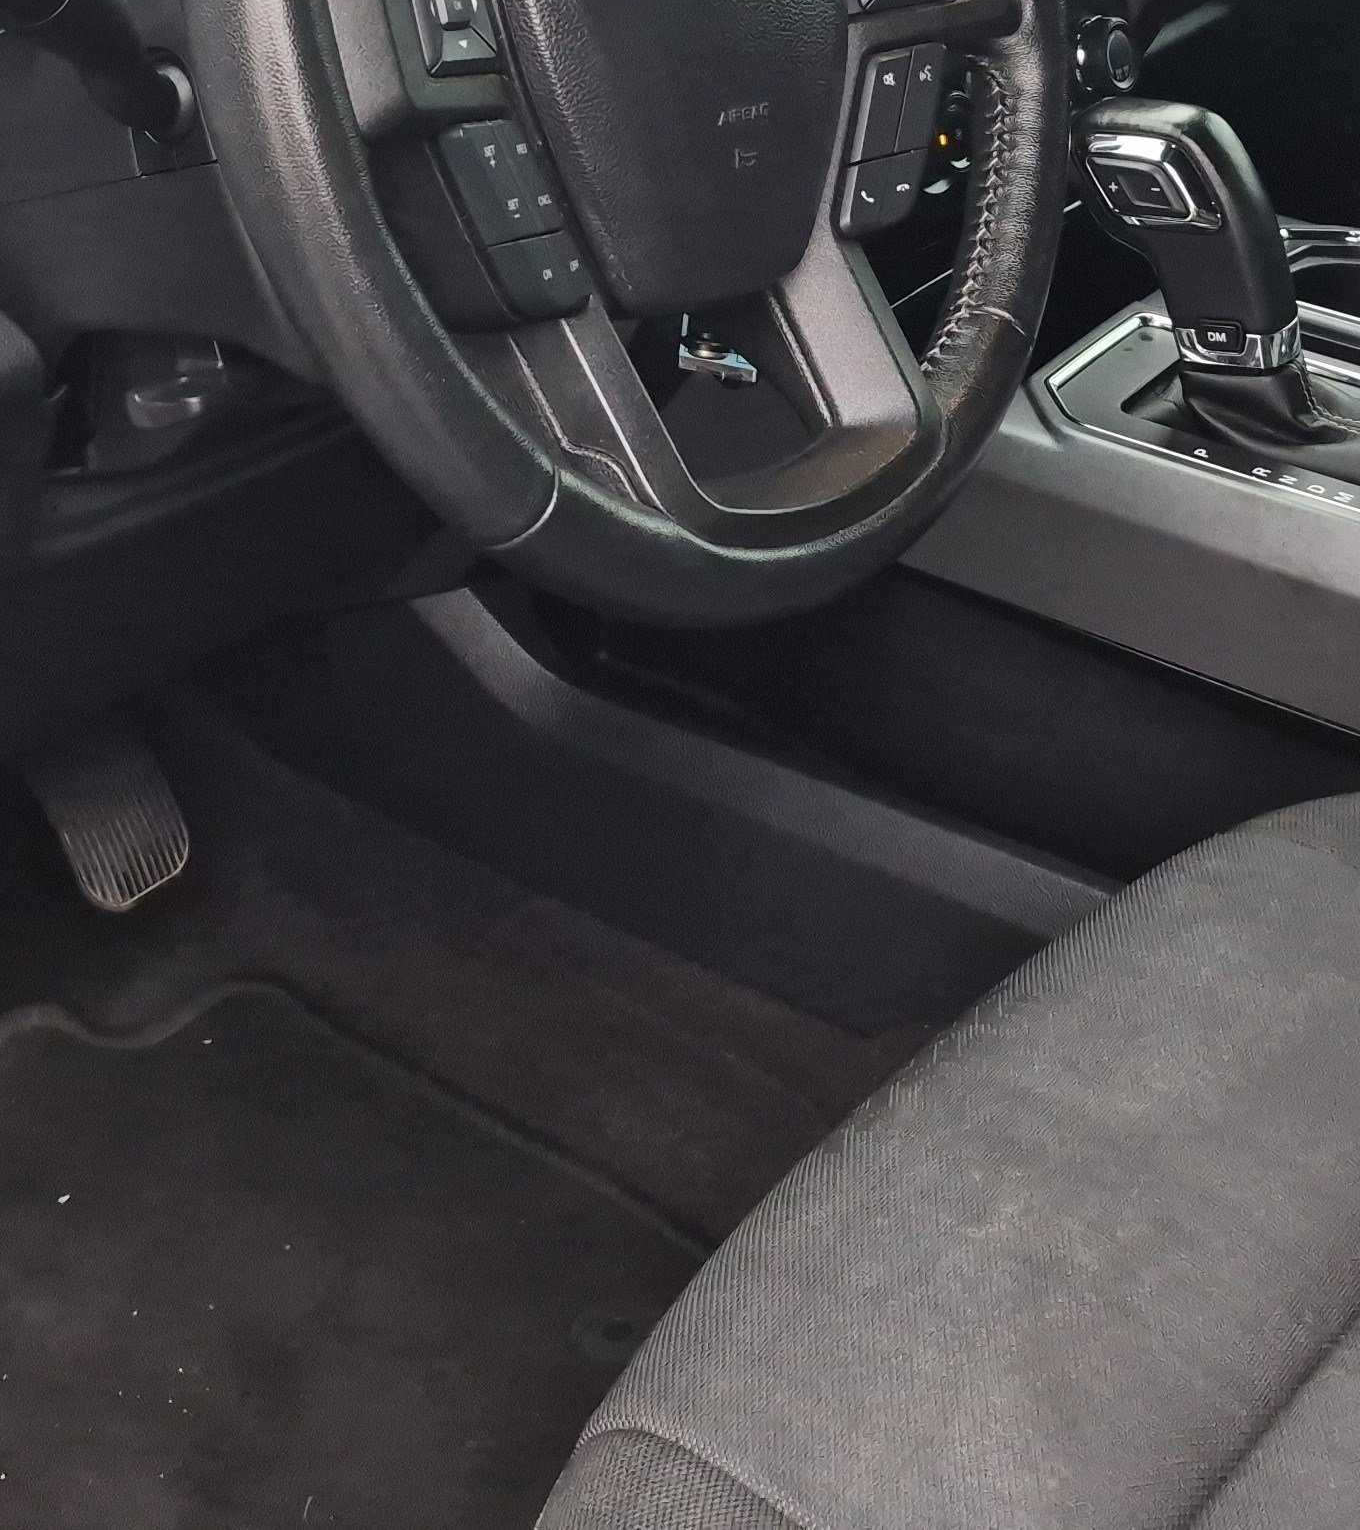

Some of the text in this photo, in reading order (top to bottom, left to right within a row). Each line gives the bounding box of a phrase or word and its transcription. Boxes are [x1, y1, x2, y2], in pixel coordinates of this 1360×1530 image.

[1193, 448, 1355, 503] P R N D M
